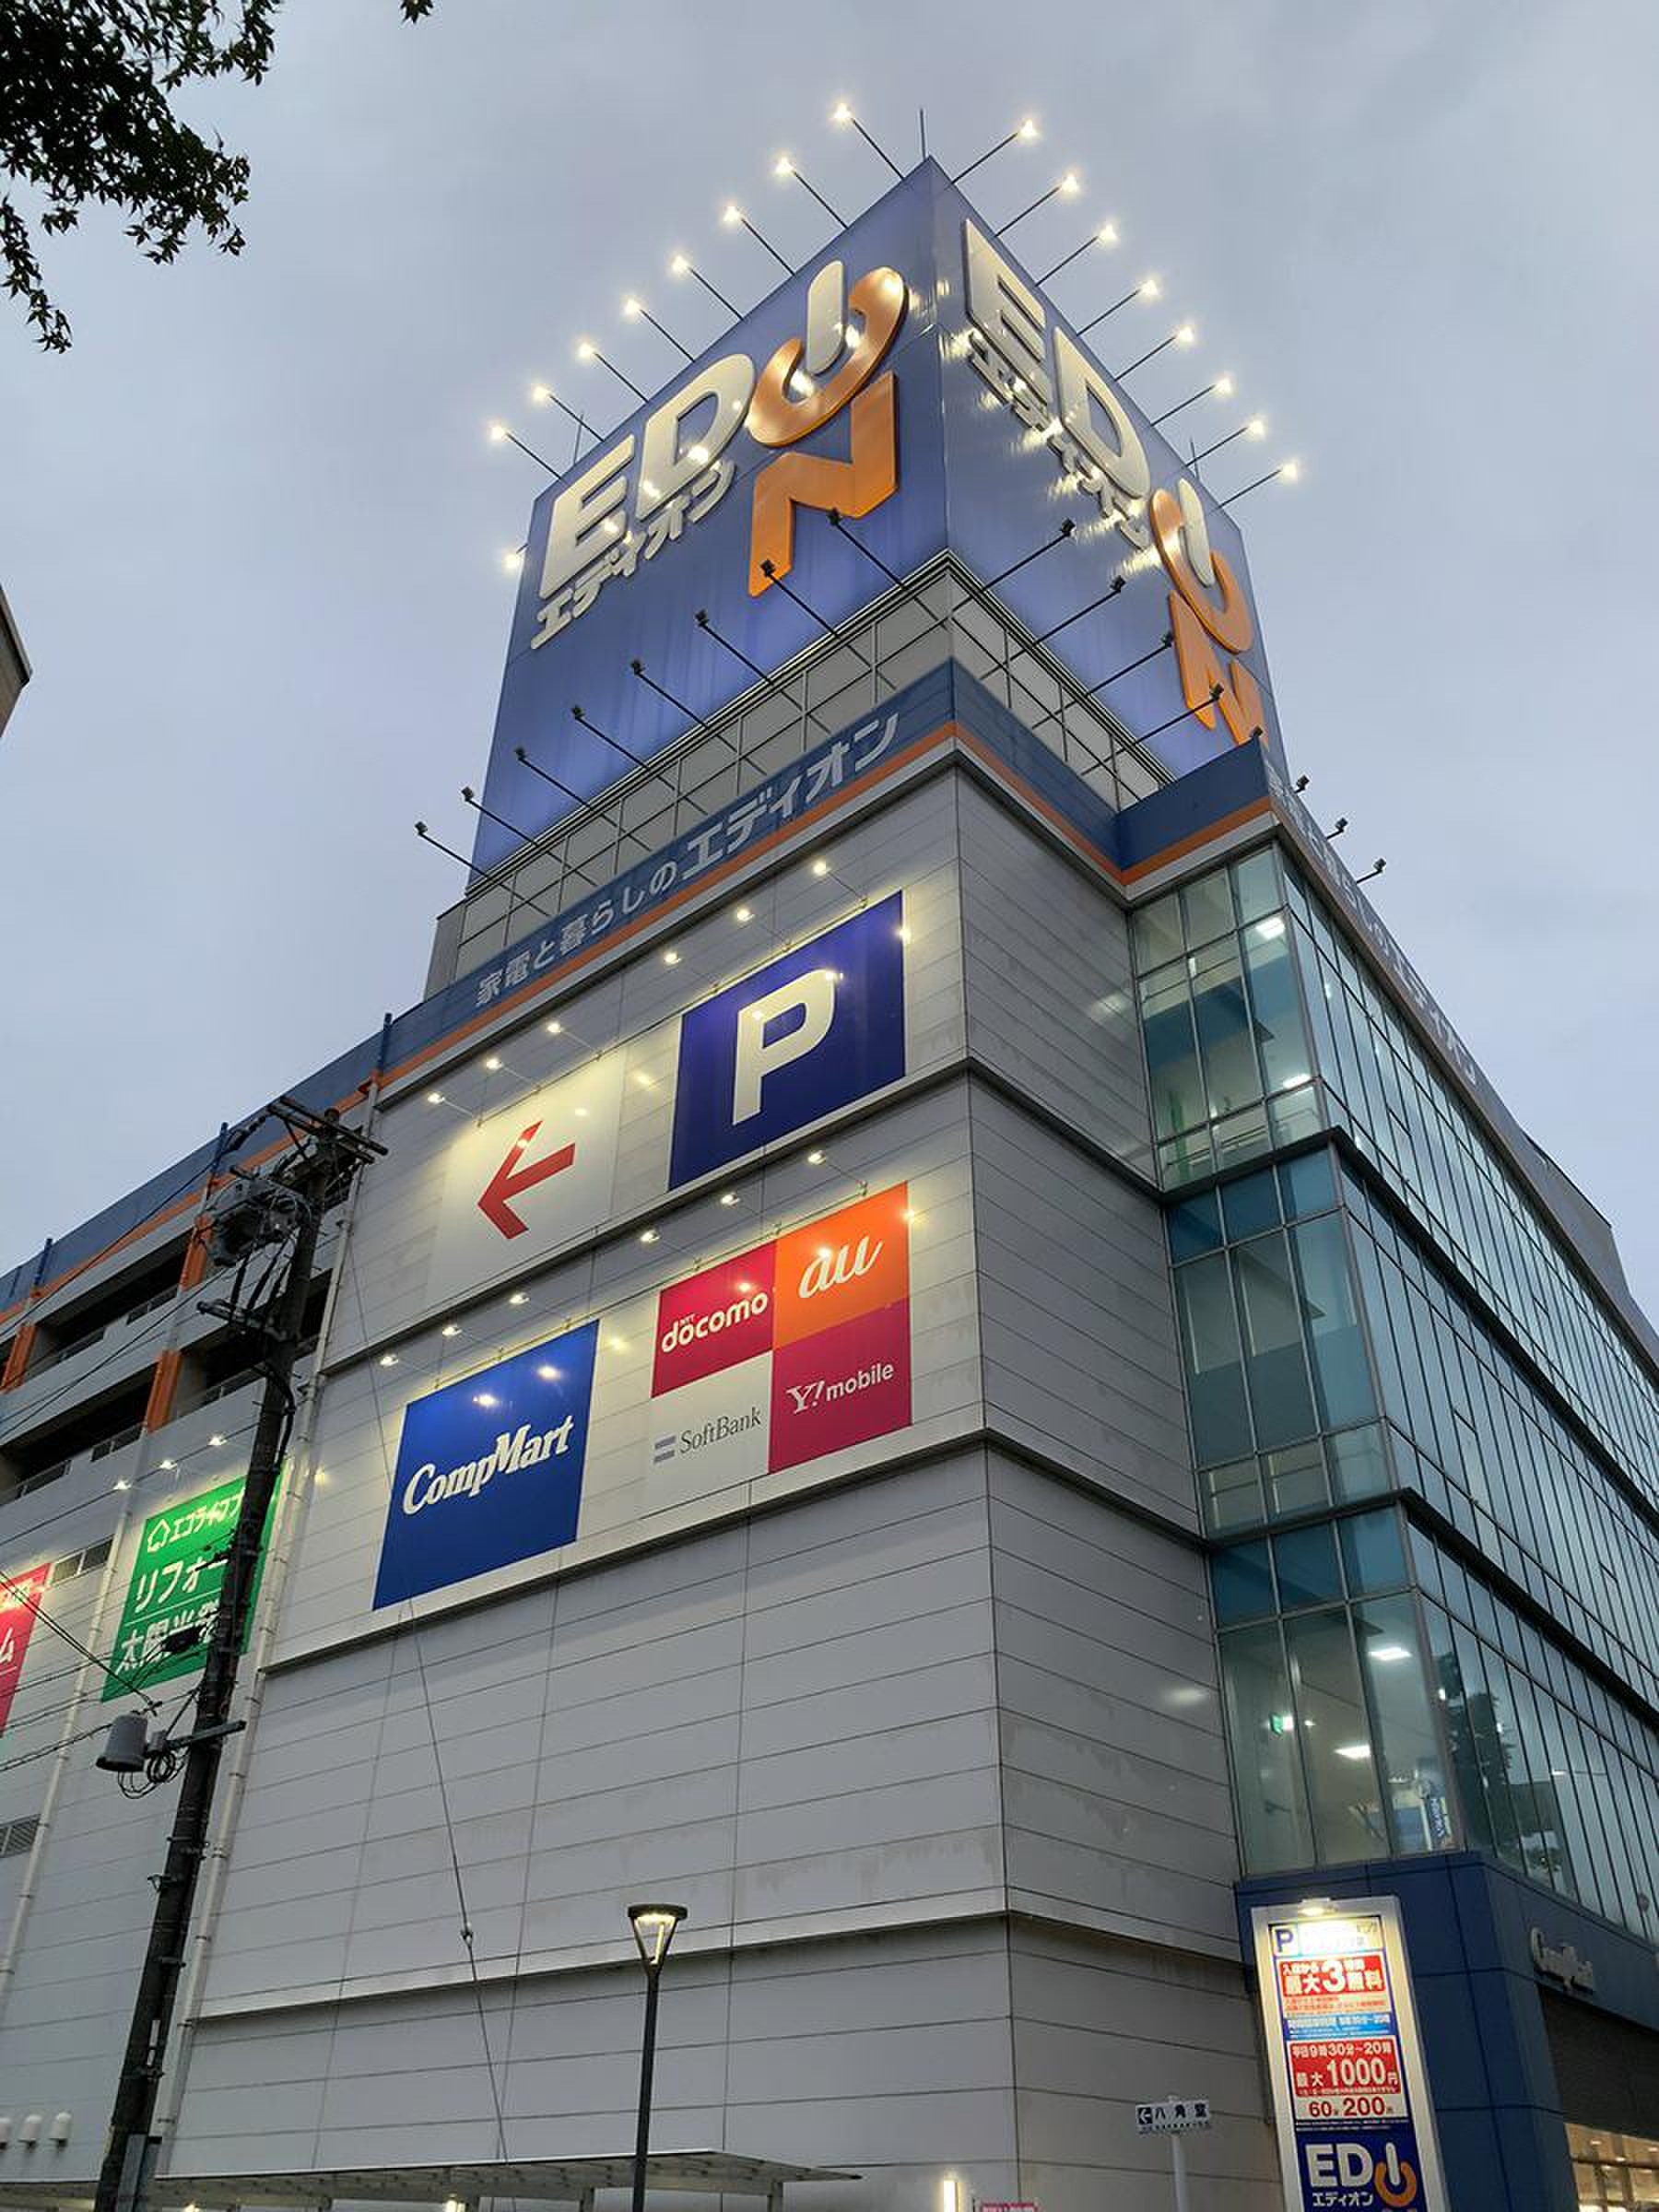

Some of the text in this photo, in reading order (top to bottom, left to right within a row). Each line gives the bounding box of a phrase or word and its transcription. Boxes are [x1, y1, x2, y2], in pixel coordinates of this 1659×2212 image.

[538, 260, 909, 598] EDION
[530, 460, 736, 650] エディオン
[475, 712, 900, 1008] 家電と暮らしのエディオン
[733, 969, 835, 1126] P
[797, 1236, 884, 1299] au
[661, 1291, 768, 1353] docomo
[403, 1415, 573, 1515] CompMart
[679, 1406, 762, 1454] SoftBank
[135, 1556, 229, 1613] リフォー
[114, 1597, 221, 1676] 太陽光発
[1275, 1928, 1294, 1953] P
[1305, 2142, 1418, 2212] EDIO
[1312, 2191, 1374, 2208] エディオン
